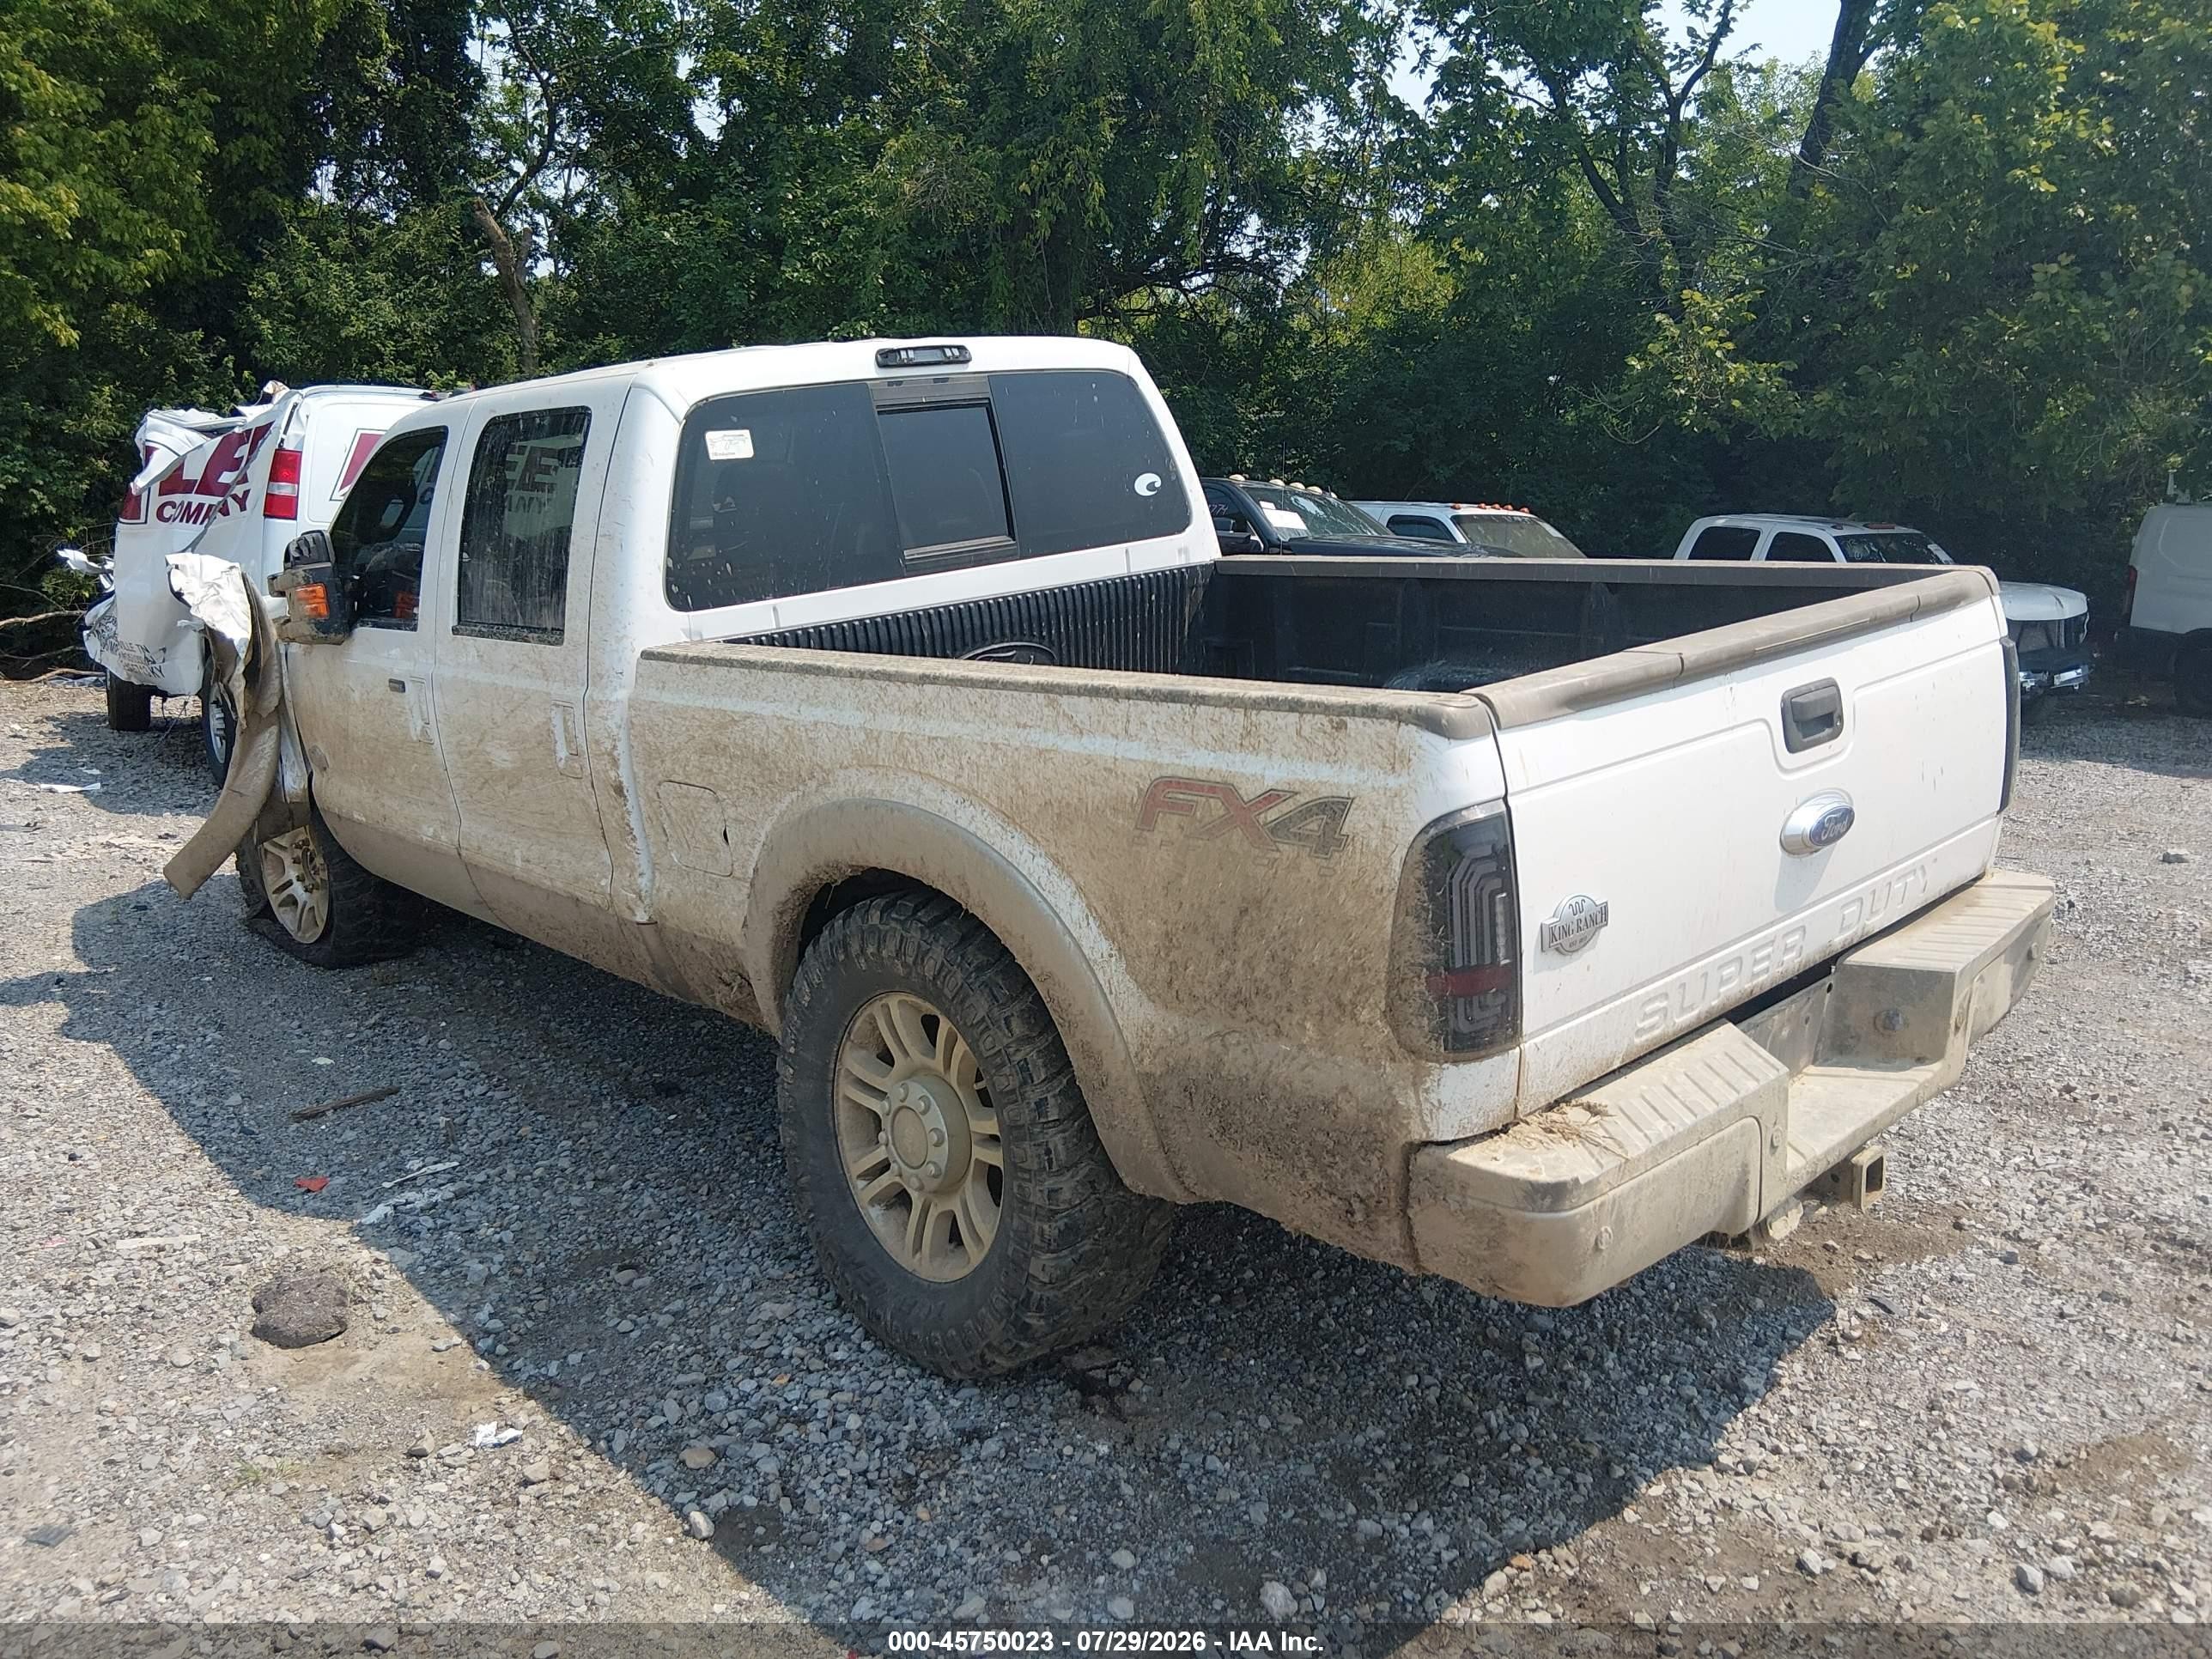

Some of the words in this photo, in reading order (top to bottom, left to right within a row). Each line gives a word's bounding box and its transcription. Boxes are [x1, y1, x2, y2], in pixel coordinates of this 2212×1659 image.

[155, 488, 252, 526] COMPNY
[1135, 775, 1355, 859] FX4
[1820, 810, 1850, 842] Ford
[1550, 921, 1574, 944] KING
[1576, 904, 1607, 933] RANCH
[1633, 924, 1807, 1044] SUPER
[1834, 863, 1929, 944] DUTY
